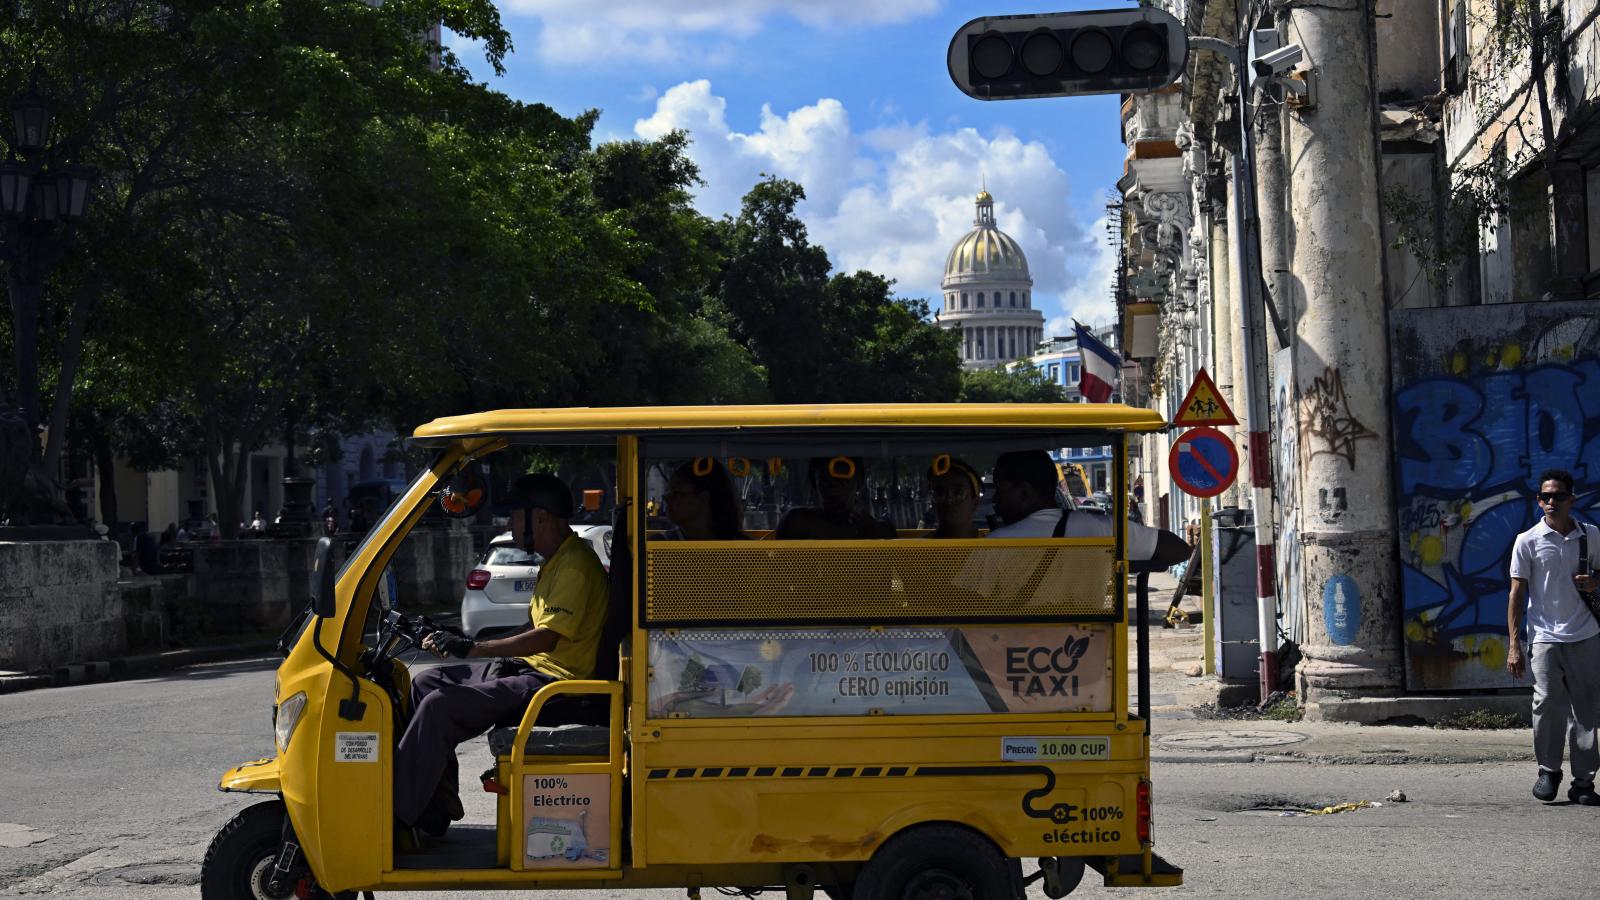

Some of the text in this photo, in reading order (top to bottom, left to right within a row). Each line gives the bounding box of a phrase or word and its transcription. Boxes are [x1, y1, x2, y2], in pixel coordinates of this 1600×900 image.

[810, 648, 949, 673] 100 % ECOLÓGICO
[1006, 646, 1079, 674] ECO
[838, 675, 949, 697] CERO emisión
[1006, 675, 1079, 697] TAXI
[1042, 743, 1077, 756] 10,00
[1080, 743, 1106, 756] CUP
[533, 778, 568, 789] 100%
[533, 794, 591, 807] Eléctrico
[1081, 806, 1124, 821] 100%
